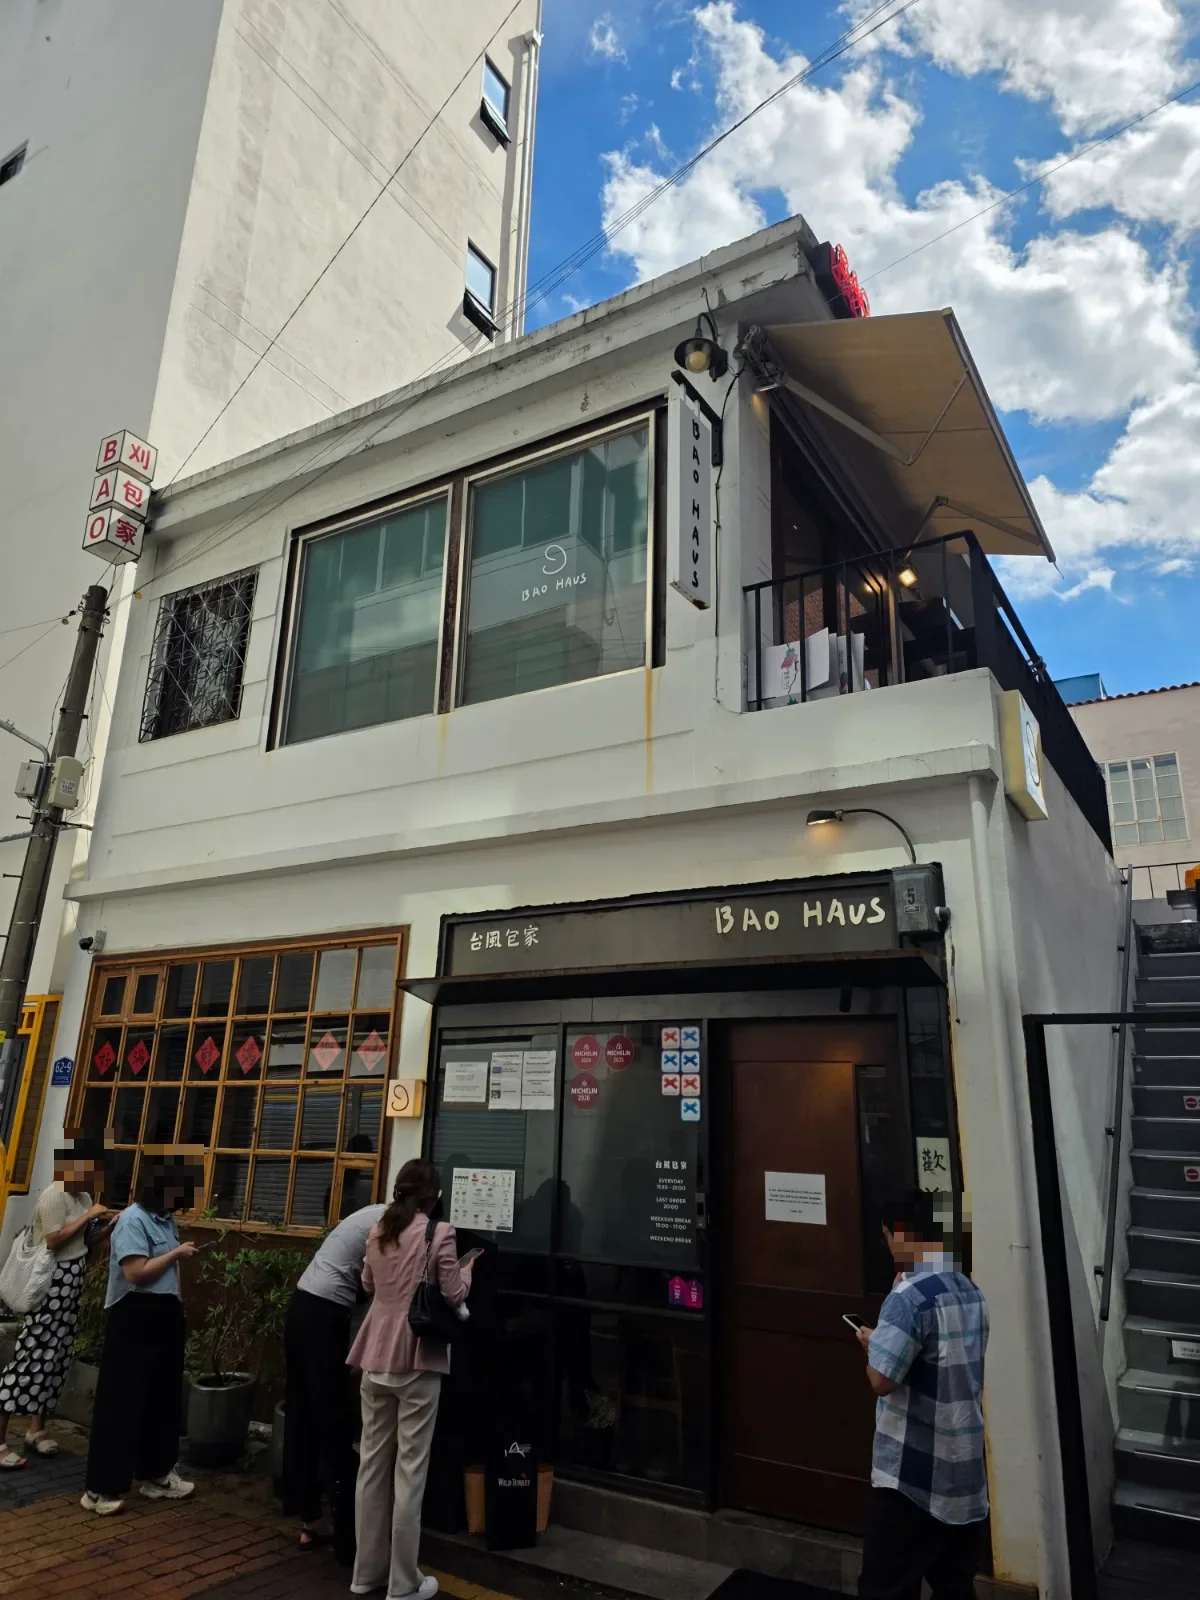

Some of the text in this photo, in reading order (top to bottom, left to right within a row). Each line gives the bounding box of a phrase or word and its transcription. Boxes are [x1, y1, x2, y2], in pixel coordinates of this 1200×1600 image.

[691, 418, 701, 588] BAO HAUS
[522, 572, 587, 602] BAO HAUS
[715, 897, 886, 934] BAO HAUS
[55, 1061, 72, 1073] 62-9
[570, 1087, 598, 1095] MICHELIN
[498, 1478, 530, 1487] WILD TURKEY
